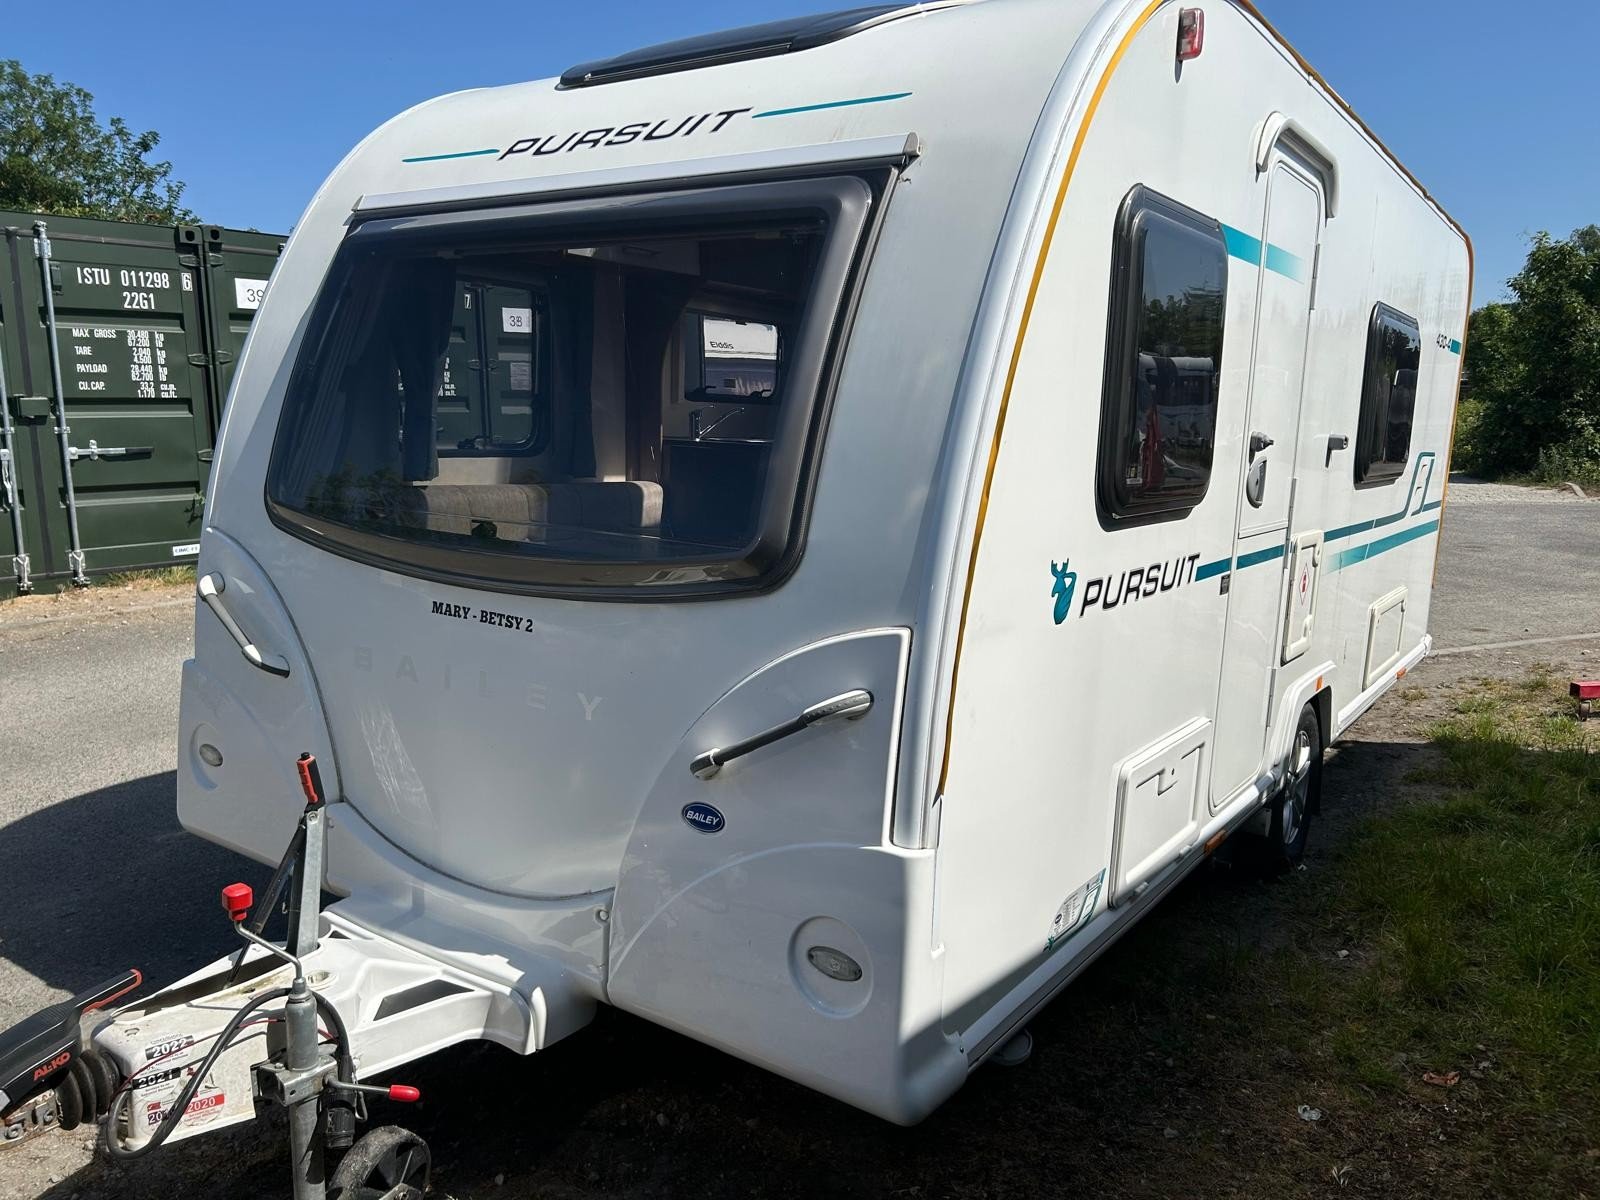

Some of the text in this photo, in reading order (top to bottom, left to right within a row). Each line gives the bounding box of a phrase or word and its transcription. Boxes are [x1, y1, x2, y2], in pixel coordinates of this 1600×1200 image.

[497, 106, 754, 161] PURSUIT
[76, 267, 193, 291] ISTU 011298 6
[122, 291, 155, 310] 22G1
[72, 328, 90, 338] MAX
[94, 329, 117, 339] GROSS
[154, 331, 165, 342] kg
[155, 339, 164, 348] lb
[74, 346, 93, 356] TARE
[156, 348, 166, 359] kg
[76, 364, 108, 373] PAYLOAD
[158, 366, 168, 376] kg
[137, 390, 155, 398] 1.170
[1079, 552, 1201, 618] PURSUIT
[431, 601, 471, 620] MARY
[480, 609, 524, 630] BETSY
[525, 618, 534, 633] 2
[352, 646, 603, 721] BAILEY
[686, 810, 721, 826] BAILEY
[152, 1038, 187, 1058] 2022
[188, 1096, 216, 1112] 2020
